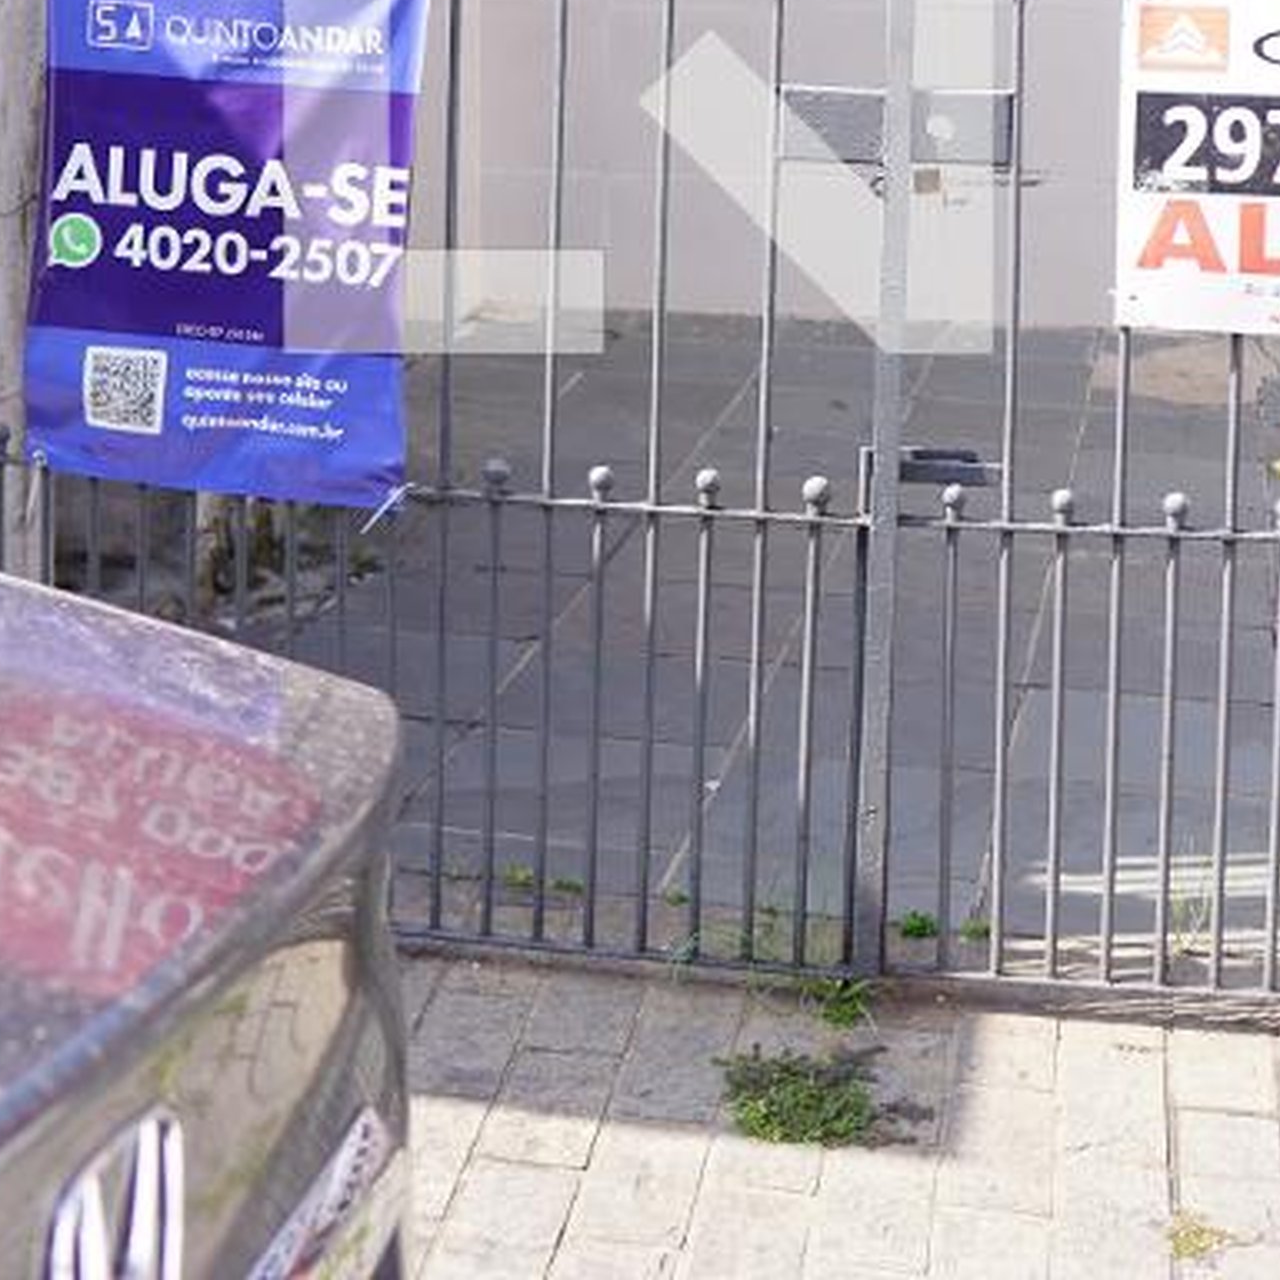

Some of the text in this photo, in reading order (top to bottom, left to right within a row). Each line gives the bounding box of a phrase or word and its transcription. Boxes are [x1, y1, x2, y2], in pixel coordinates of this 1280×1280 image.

[166, 18, 384, 55] QUINTOANDAR
[52, 142, 410, 228] ALUGA-SE
[115, 224, 403, 288] 4020-2507
